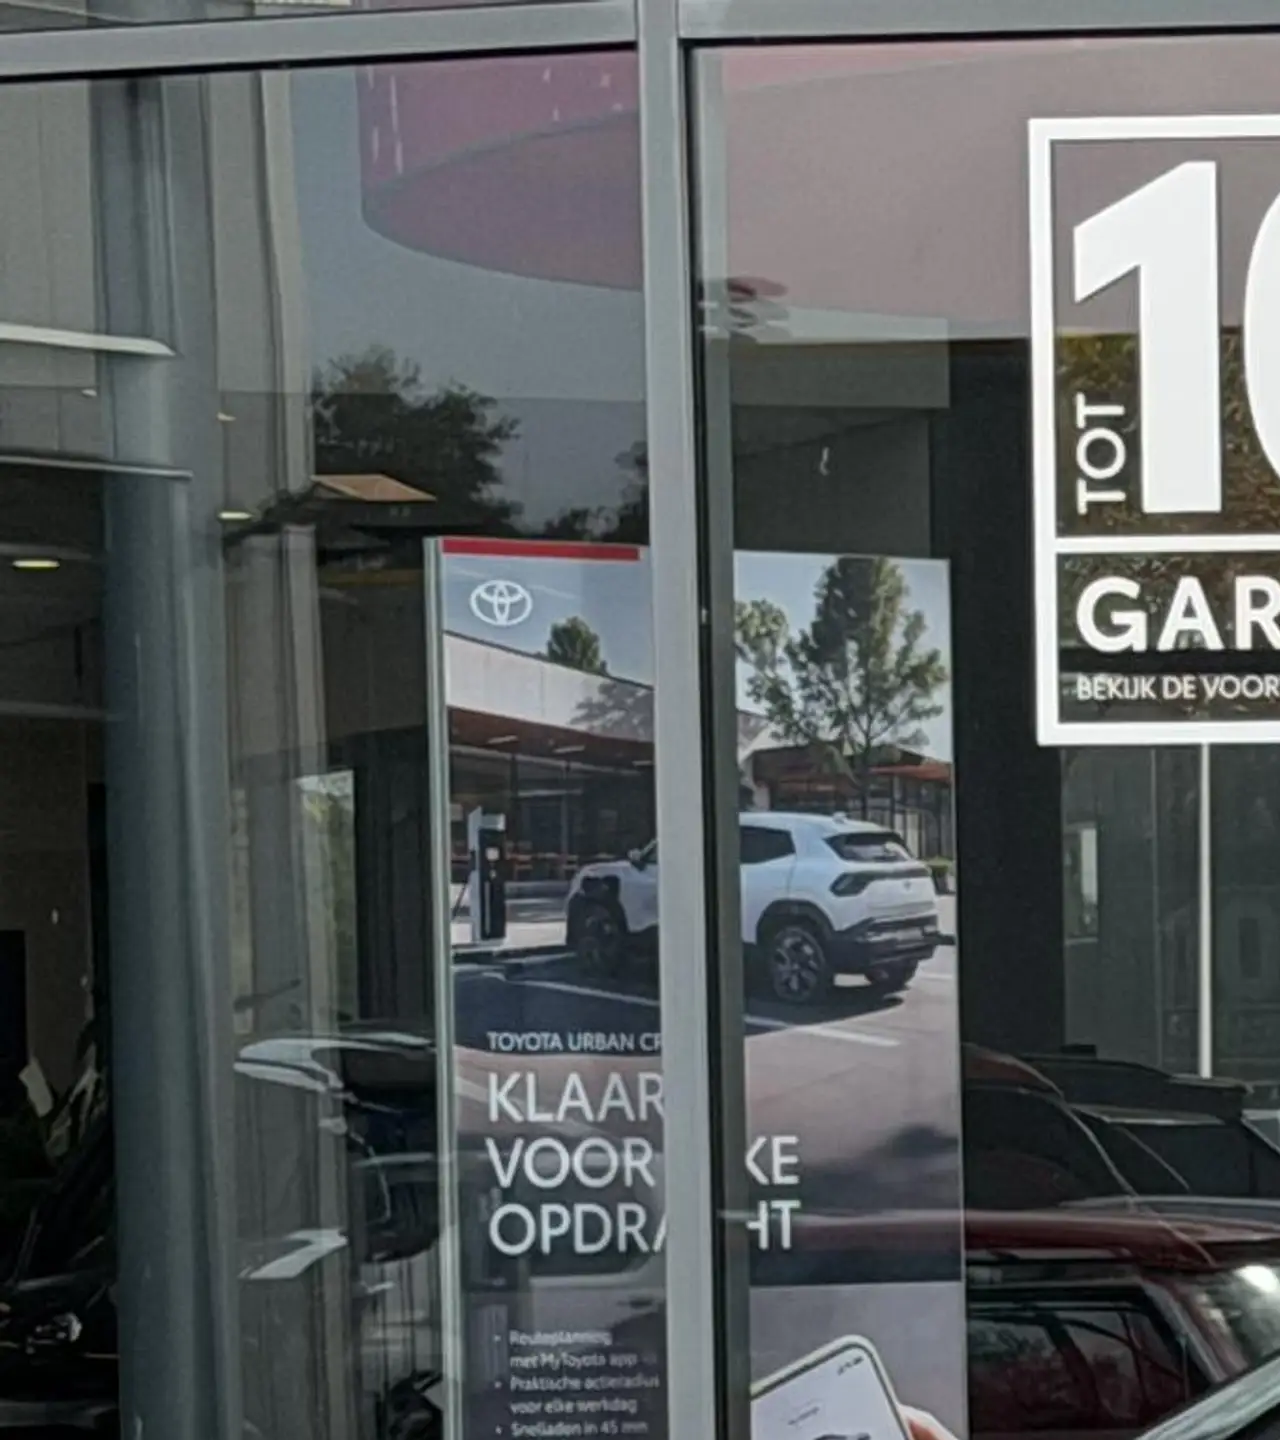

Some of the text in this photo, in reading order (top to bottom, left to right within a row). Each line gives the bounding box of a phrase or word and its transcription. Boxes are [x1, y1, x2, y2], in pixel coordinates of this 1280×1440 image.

[1075, 392, 1126, 515] TOT
[1077, 674, 1157, 700] BEKIJK
[1163, 674, 1197, 699] DE
[487, 1032, 563, 1051] TOYOTA
[567, 1032, 635, 1051] URBAN
[488, 1071, 664, 1123] KLAAR
[485, 1136, 656, 1189] VOOR
[489, 1199, 801, 1255] OPDRHT
